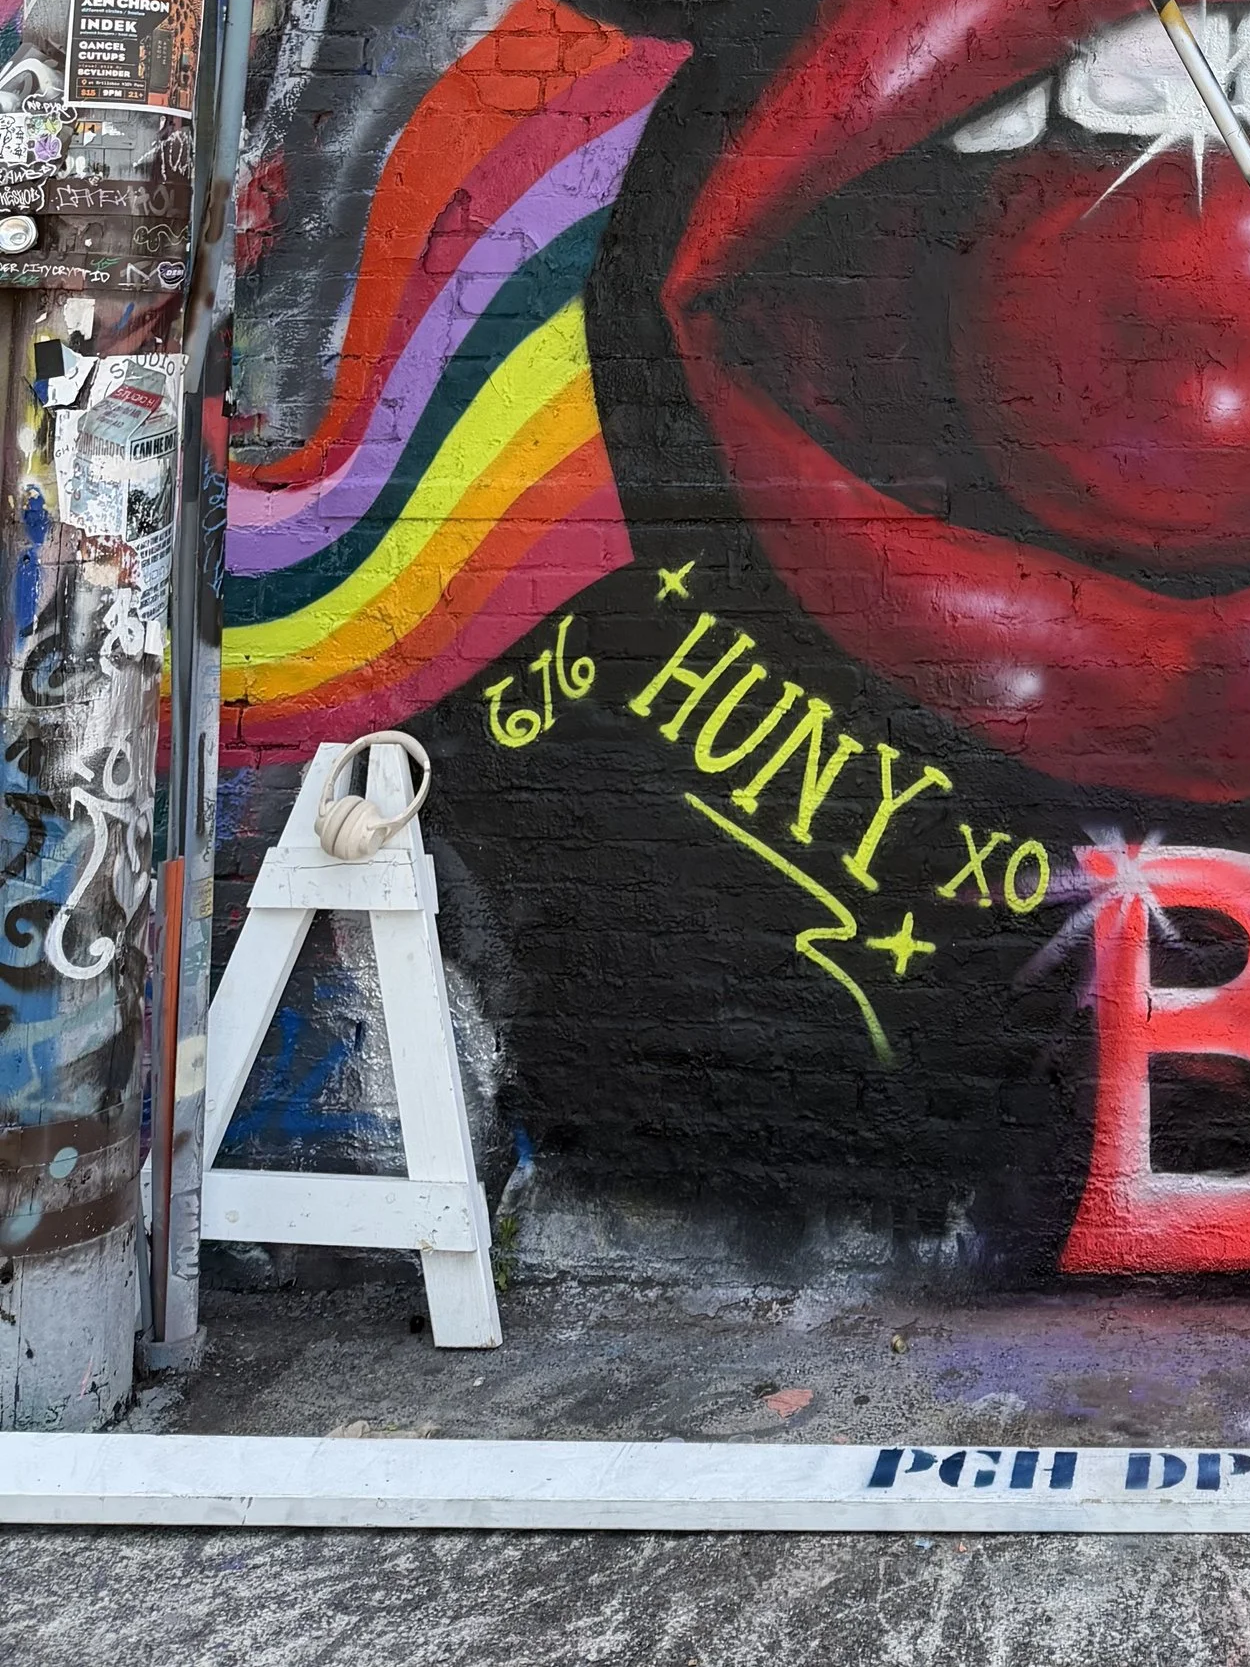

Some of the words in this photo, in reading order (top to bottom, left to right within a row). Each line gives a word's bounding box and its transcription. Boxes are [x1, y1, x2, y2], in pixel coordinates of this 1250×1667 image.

[80, 18, 138, 33] INDEK
[78, 40, 126, 52] QANCEL
[78, 51, 126, 62] CUTUPS
[102, 89, 123, 97] 9PM
[626, 611, 953, 893] HUNY
[936, 823, 1051, 914] XO
[866, 1446, 1079, 1489] PGH
